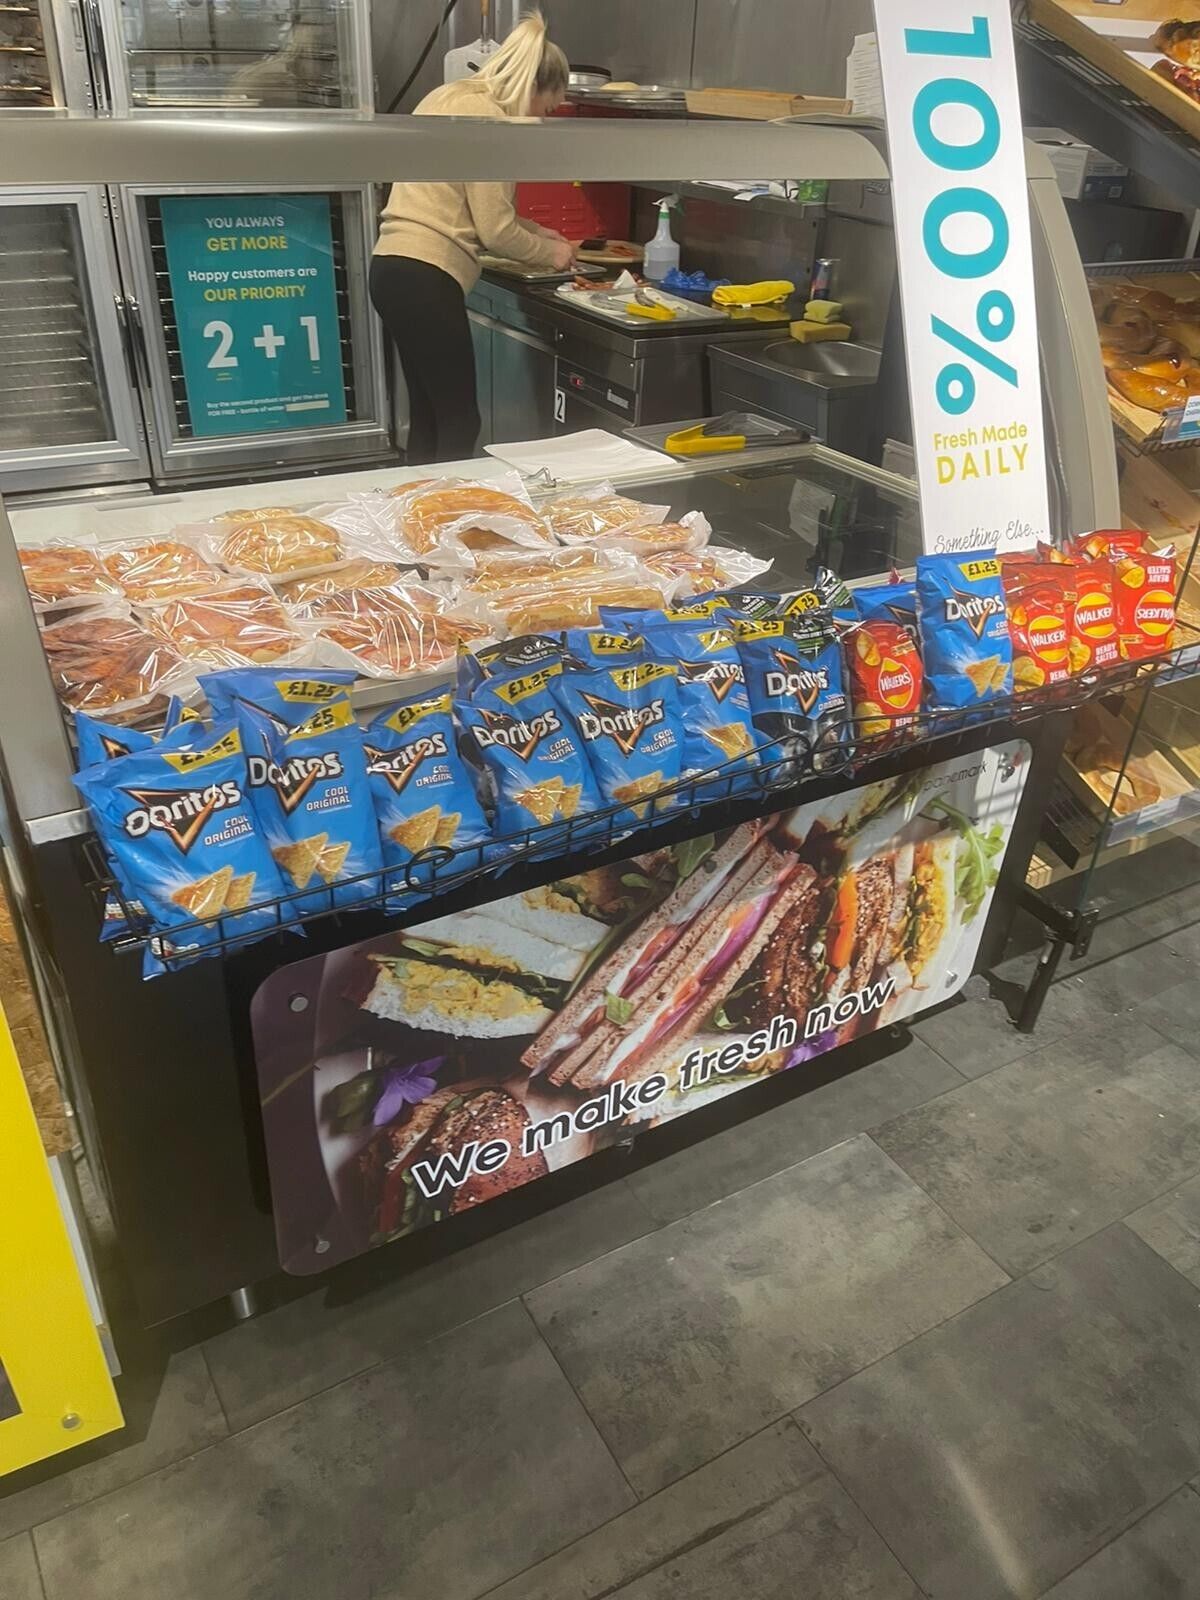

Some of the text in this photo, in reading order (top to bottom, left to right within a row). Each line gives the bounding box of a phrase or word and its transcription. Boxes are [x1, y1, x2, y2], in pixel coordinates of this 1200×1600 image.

[205, 216, 285, 229] YOU ALWAYS
[904, 16, 1018, 415] 100%
[207, 235, 288, 251] GET MORE
[188, 267, 317, 282] Happy customers are
[204, 285, 306, 301] OUR PRIORITY
[203, 320, 238, 368] 2
[300, 316, 320, 361] 1
[934, 421, 1027, 450] Fresh Made
[936, 443, 1028, 484] DAILY
[934, 520, 1044, 553] Something Else...
[968, 560, 998, 575] £1.25
[946, 595, 1005, 620] Doritos
[1076, 607, 1113, 625] WALKE
[740, 620, 779, 635] £.25
[598, 636, 636, 650] £1.2
[1030, 630, 1067, 646] WALKER
[1095, 642, 1117, 655] READY
[1095, 650, 1118, 664] SALTED
[287, 681, 337, 698] £1.25
[508, 669, 551, 699] £1.25
[296, 708, 335, 733] .25
[399, 700, 442, 727] £1.
[578, 699, 664, 740] Doritos
[471, 709, 560, 747] Doritos
[654, 728, 673, 741] COOL
[366, 733, 447, 774] oritos
[550, 738, 571, 752] COOL
[249, 752, 343, 787] Doritos
[325, 786, 349, 797] COOL
[125, 782, 241, 837] Doritos
[306, 796, 351, 811] ORIGINAL
[224, 815, 249, 828] COOL
[204, 823, 253, 845] ORIGINAL
[410, 976, 896, 1199] We make fresh now
